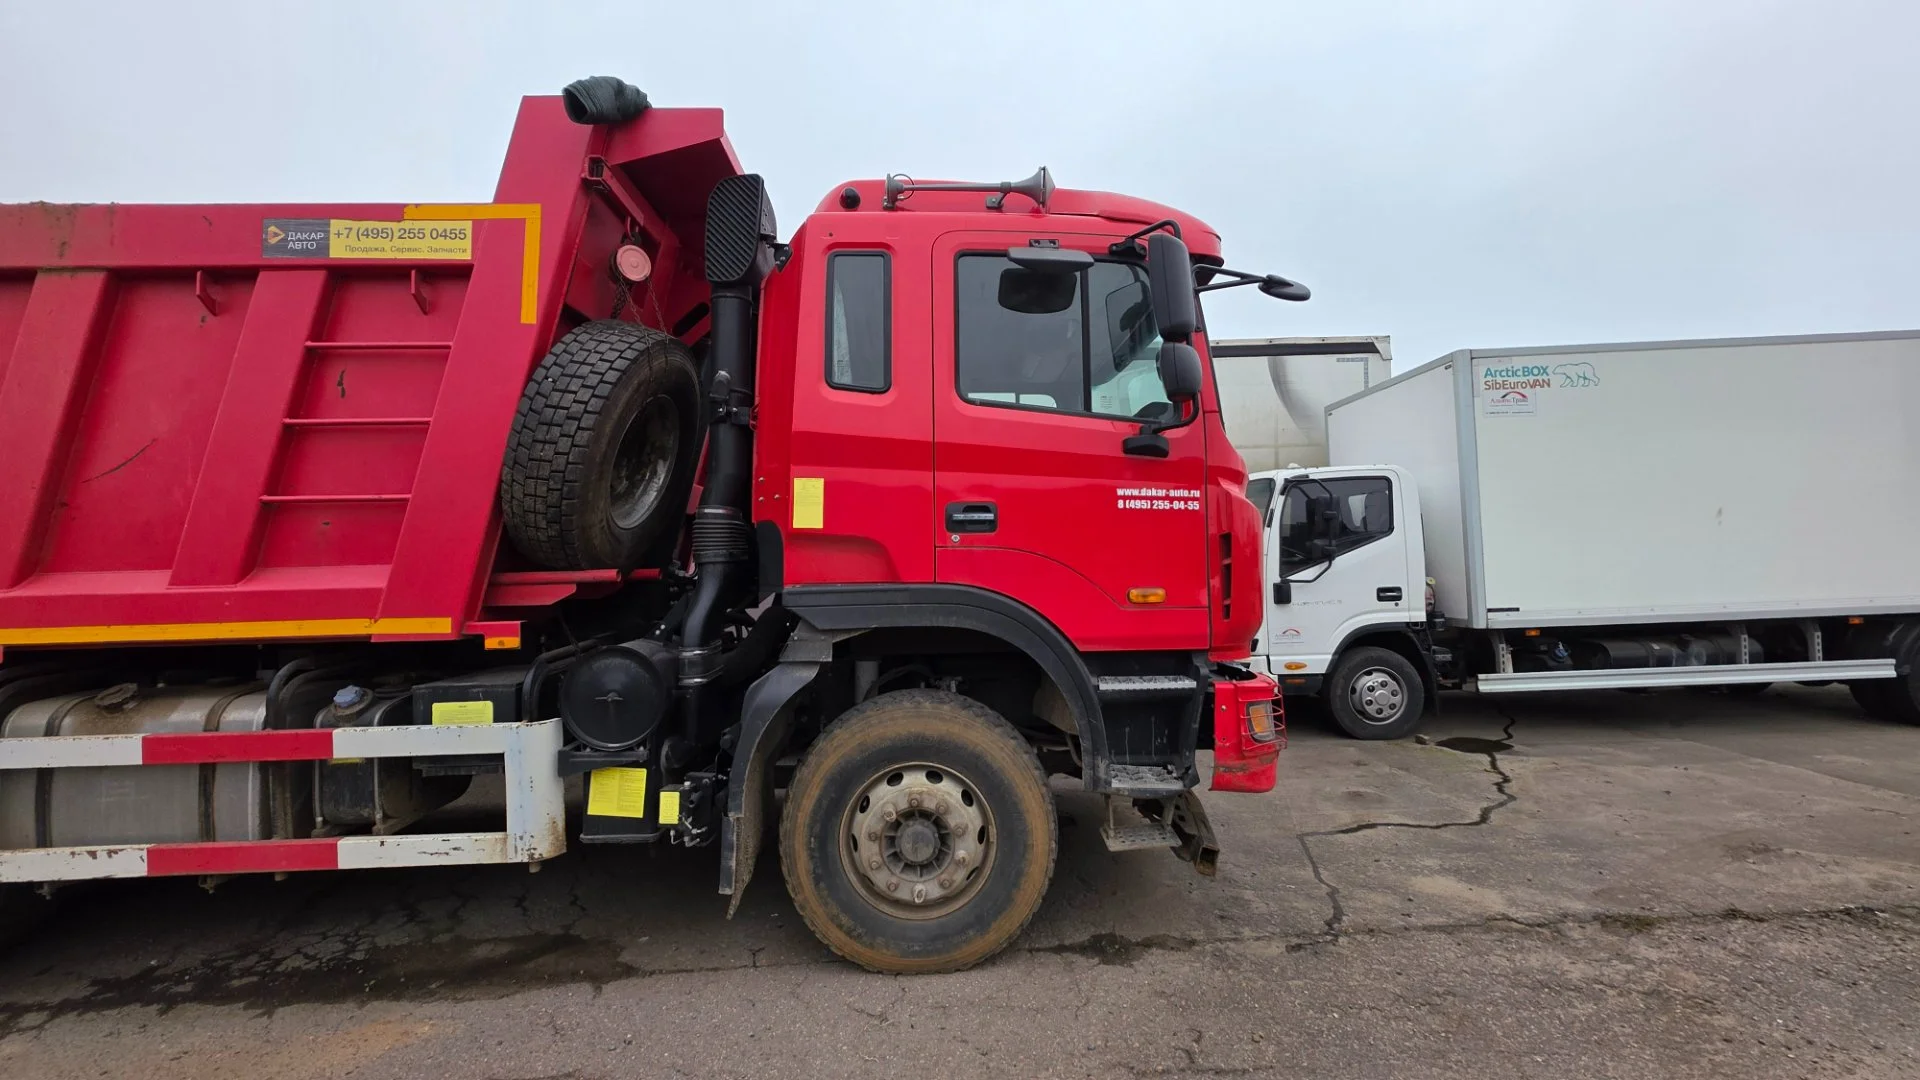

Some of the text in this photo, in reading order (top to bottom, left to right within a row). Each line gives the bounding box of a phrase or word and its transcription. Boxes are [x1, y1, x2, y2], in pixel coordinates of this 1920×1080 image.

[288, 232, 324, 241] ДАКАР
[334, 227, 467, 242] +7 (495) 255 0455
[288, 241, 317, 250] АВТО
[427, 246, 467, 254] Запчасти
[1484, 378, 1551, 390] SibEuroVAN
[1116, 488, 1200, 497] www.dakar-auto.ru
[1117, 499, 1200, 510] 8 (495) 255-04-55
